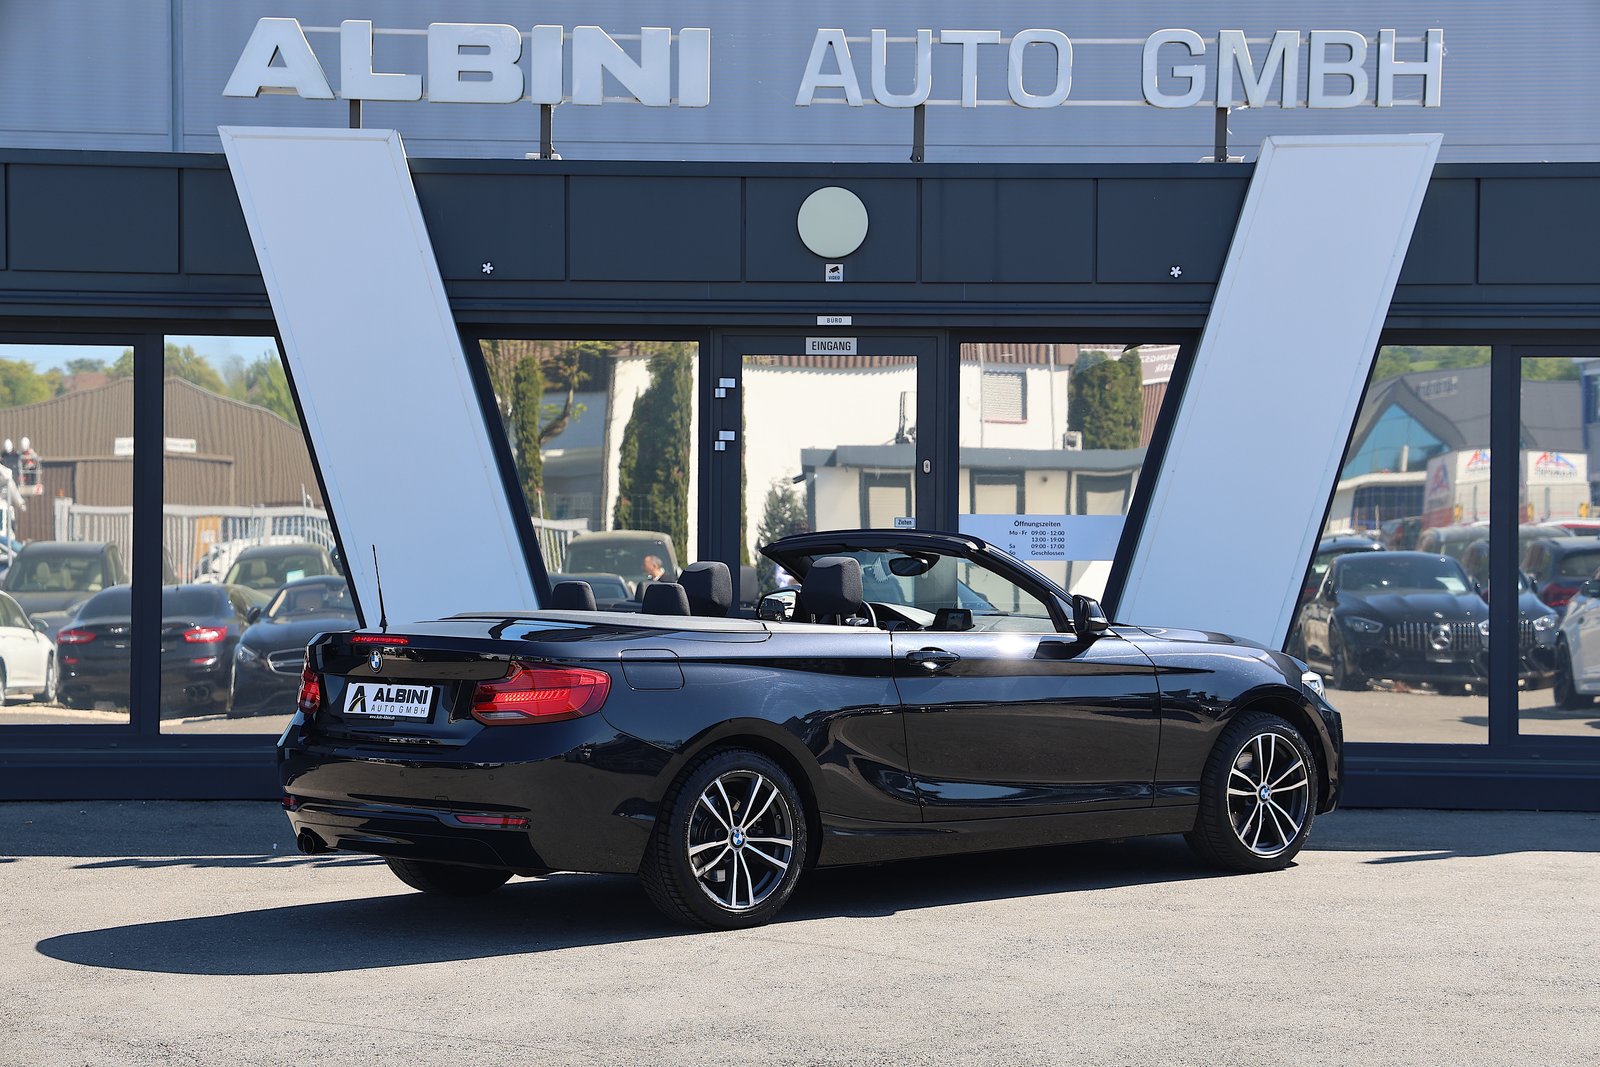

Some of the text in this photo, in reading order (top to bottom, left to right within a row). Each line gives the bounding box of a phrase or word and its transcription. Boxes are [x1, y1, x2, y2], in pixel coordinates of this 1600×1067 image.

[222, 17, 1444, 109] ALBINI AUTO GMBH
[811, 341, 852, 351] EINGANG
[1013, 520, 1061, 528] Öffnungszeiten
[373, 687, 429, 705] ALBINI
[370, 704, 426, 715] AUTO GMBH
